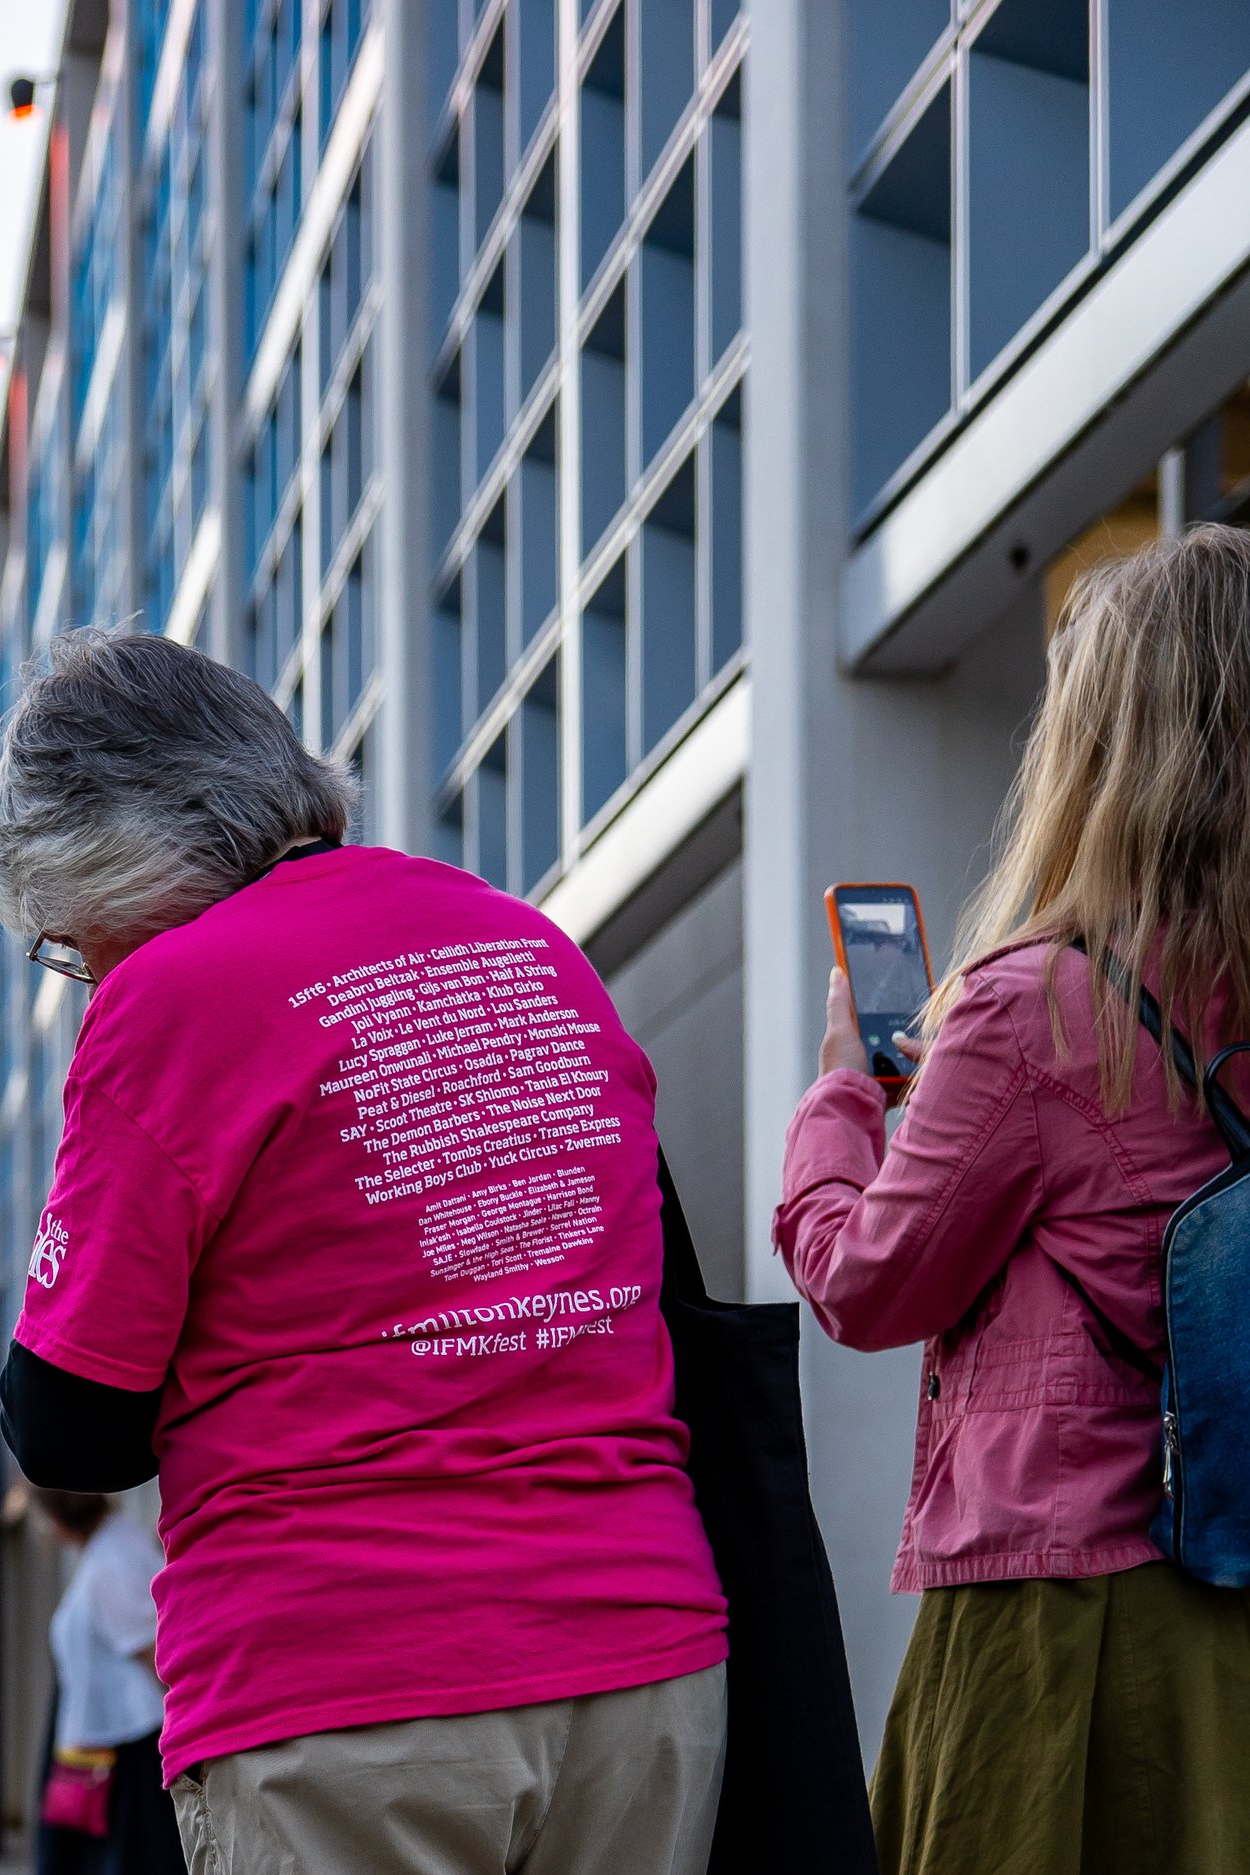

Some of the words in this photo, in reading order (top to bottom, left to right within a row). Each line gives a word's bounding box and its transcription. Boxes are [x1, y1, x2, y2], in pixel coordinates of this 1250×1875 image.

[288, 982, 326, 1008] 15ft6
[332, 960, 394, 987] Architects
[394, 956, 407, 968] of
[408, 952, 425, 965] Air
[430, 944, 469, 960] Ceilidh
[468, 939, 523, 953] Liberation
[520, 938, 549, 948] Front
[319, 1000, 369, 1027] Gandini
[366, 988, 416, 1012] Juggling
[419, 982, 441, 996] Gijs
[440, 979, 463, 990] van
[461, 975, 486, 987] Bon
[488, 967, 514, 982] Half
[514, 967, 525, 978] A
[524, 965, 558, 978] String
[326, 982, 376, 1007] Deabru
[374, 969, 420, 989] Beltzak
[424, 958, 480, 977] Ensemble
[480, 951, 536, 968] Augelletti
[351, 1015, 374, 1034] Joli
[372, 1006, 412, 1025] Vyann
[486, 984, 514, 998] Klub
[513, 980, 544, 994] Girko
[351, 1037, 368, 1049] La
[367, 1028, 394, 1043] Voix
[398, 1023, 414, 1035] Le
[412, 1015, 442, 1030] Vent
[442, 1013, 458, 1024] du
[457, 1004, 487, 1021] Nord
[490, 1002, 514, 1014] Lou
[513, 995, 558, 1010] Sanders
[319, 1069, 379, 1097] Maureen
[379, 1051, 432, 1077] Onwunali
[436, 1039, 482, 1060] Michael
[480, 1033, 522, 1050] Pendry
[527, 1023, 568, 1041] Monski
[566, 1022, 601, 1035] Mouse
[339, 1054, 368, 1072] Lucy
[369, 1039, 421, 1062] Spraggan
[425, 1031, 455, 1045] Luke
[454, 1022, 493, 1042] Jerram
[497, 1014, 528, 1029] Mark
[528, 1009, 579, 1024] Anderson
[353, 1082, 391, 1103] NoFit
[390, 1074, 421, 1091] State
[421, 1064, 458, 1082] Circus
[509, 1045, 549, 1061] Pagrav
[550, 1040, 585, 1054] Dance
[357, 1101, 389, 1120] Peat
[390, 1096, 399, 1110] &
[400, 1085, 435, 1107] Diesel
[442, 1069, 501, 1094] Roachford
[508, 1065, 535, 1079] Sam
[535, 1056, 591, 1073] Goodburn
[340, 1124, 367, 1142] SAY
[376, 1112, 408, 1132] Scoot
[408, 1101, 453, 1121] Theatre
[458, 1093, 475, 1107] SK
[475, 1085, 519, 1103] Shlomo
[524, 1076, 560, 1092] Tania
[558, 1072, 572, 1085] El
[570, 1070, 609, 1083] Khoury
[363, 1138, 389, 1153] The
[390, 1124, 433, 1146] Demon
[432, 1111, 480, 1132] Barbers
[485, 1104, 511, 1117] The
[510, 1097, 545, 1111] Noise
[545, 1089, 576, 1105] Next
[575, 1087, 601, 1099] Door
[354, 1175, 383, 1190] The
[384, 1159, 435, 1183] Selecter
[442, 1145, 482, 1164] Tombs
[483, 1133, 532, 1153] Creatius
[538, 1123, 579, 1140] Transe
[579, 1117, 621, 1132] Express
[382, 1150, 408, 1165] The
[409, 1132, 460, 1157] Rubbish
[460, 1114, 540, 1142] Shakespeare
[540, 1104, 594, 1122] Company
[365, 1180, 423, 1205] Working
[424, 1171, 454, 1188] Boys
[455, 1161, 482, 1178] Club
[488, 1151, 518, 1168] Yuck
[519, 1144, 558, 1161] Circus
[564, 1133, 621, 1151] Zwermers
[426, 1202, 442, 1213] Amit
[442, 1194, 467, 1207] Dattani
[472, 1189, 487, 1198] Amy
[488, 1184, 507, 1194] Birks
[512, 1179, 527, 1187] Ben
[528, 1173, 552, 1184] Jordan
[556, 1166, 586, 1177] Blunden
[418, 1217, 432, 1226] Dan
[433, 1205, 472, 1221] Whitehouse
[477, 1197, 499, 1208] Ebony
[499, 1190, 523, 1202] Buckle
[527, 1181, 559, 1195] Elizabeth
[559, 1180, 566, 1188] &
[567, 1175, 595, 1186] Jameson
[424, 1223, 447, 1235] Fraser
[448, 1215, 476, 1228] Morgan
[481, 1206, 507, 1217] George
[508, 1197, 542, 1210] Montague
[546, 1190, 576, 1201] Harrison
[577, 1185, 593, 1195] Bond
[456, 1223, 484, 1236] Isabella
[563, 1199, 575, 1208] Fall
[422, 1249, 435, 1258] Joe
[435, 1243, 456, 1254] Miles
[460, 1237, 476, 1246] Meg
[476, 1230, 499, 1241] Wilson
[433, 1253, 453, 1266] SAJE
[495, 1237, 514, 1247] Smith
[515, 1233, 521, 1241] &
[572, 1216, 597, 1227] Nation
[444, 1273, 459, 1282] Tom
[491, 1257, 504, 1267] Tori
[505, 1253, 523, 1263] Scott
[527, 1245, 561, 1258] Tremaine
[561, 1238, 594, 1250] Dawkins
[519, 1241, 531, 1249] The
[557, 1229, 586, 1240] Tinkers
[586, 1226, 604, 1234] Lane
[473, 1268, 503, 1282] Wayland
[504, 1263, 529, 1274] Smithy
[534, 1254, 565, 1266] Wesson
[381, 1285, 642, 1339] fmiltonkeynes.org
[411, 1331, 527, 1357] @IFMKfest
